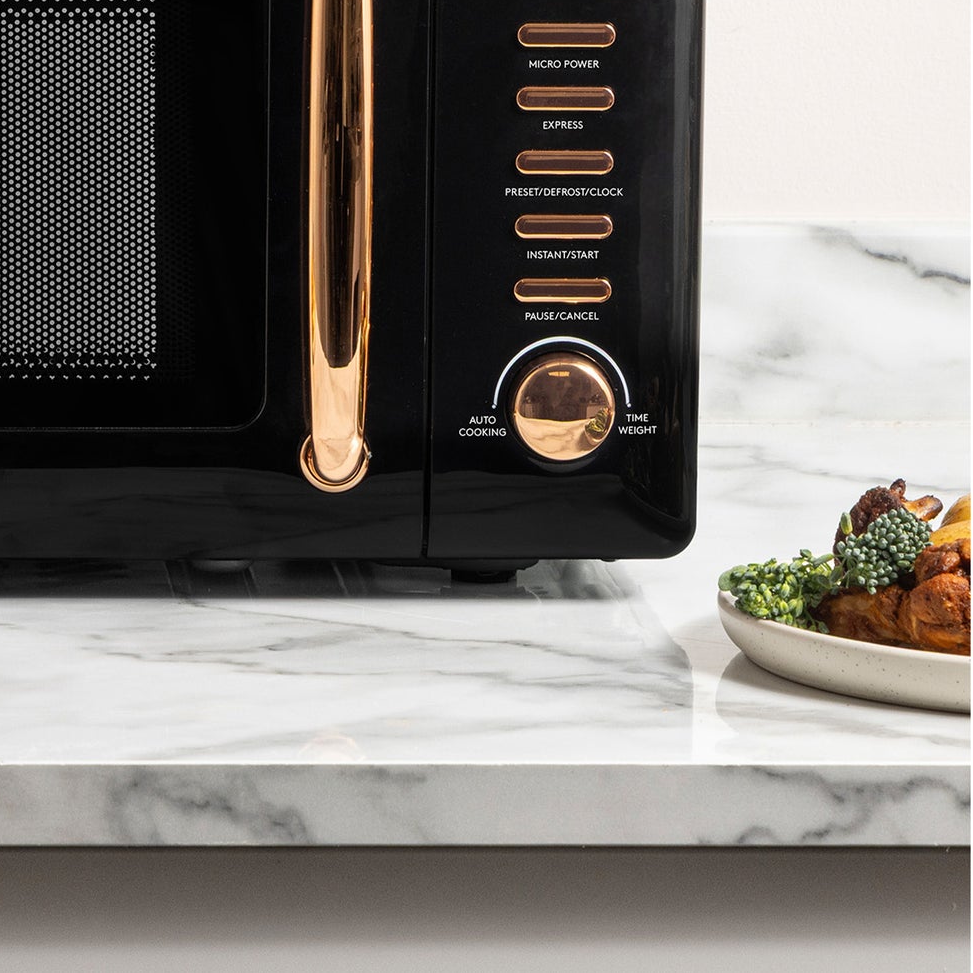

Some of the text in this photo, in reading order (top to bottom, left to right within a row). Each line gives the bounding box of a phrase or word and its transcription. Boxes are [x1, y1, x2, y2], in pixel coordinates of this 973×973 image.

[528, 59, 600, 69] MICRO POWER
[542, 120, 584, 130] EXPRESS
[505, 187, 624, 197] PRESET/DEFROST/CLOCK
[526, 250, 600, 260] INSTANT/START
[525, 311, 600, 321] PAUSE/CANCEL
[469, 415, 497, 425] AUTO
[626, 413, 649, 423] TIME
[458, 427, 507, 438] COOKING
[618, 425, 658, 435] WEIGHT
